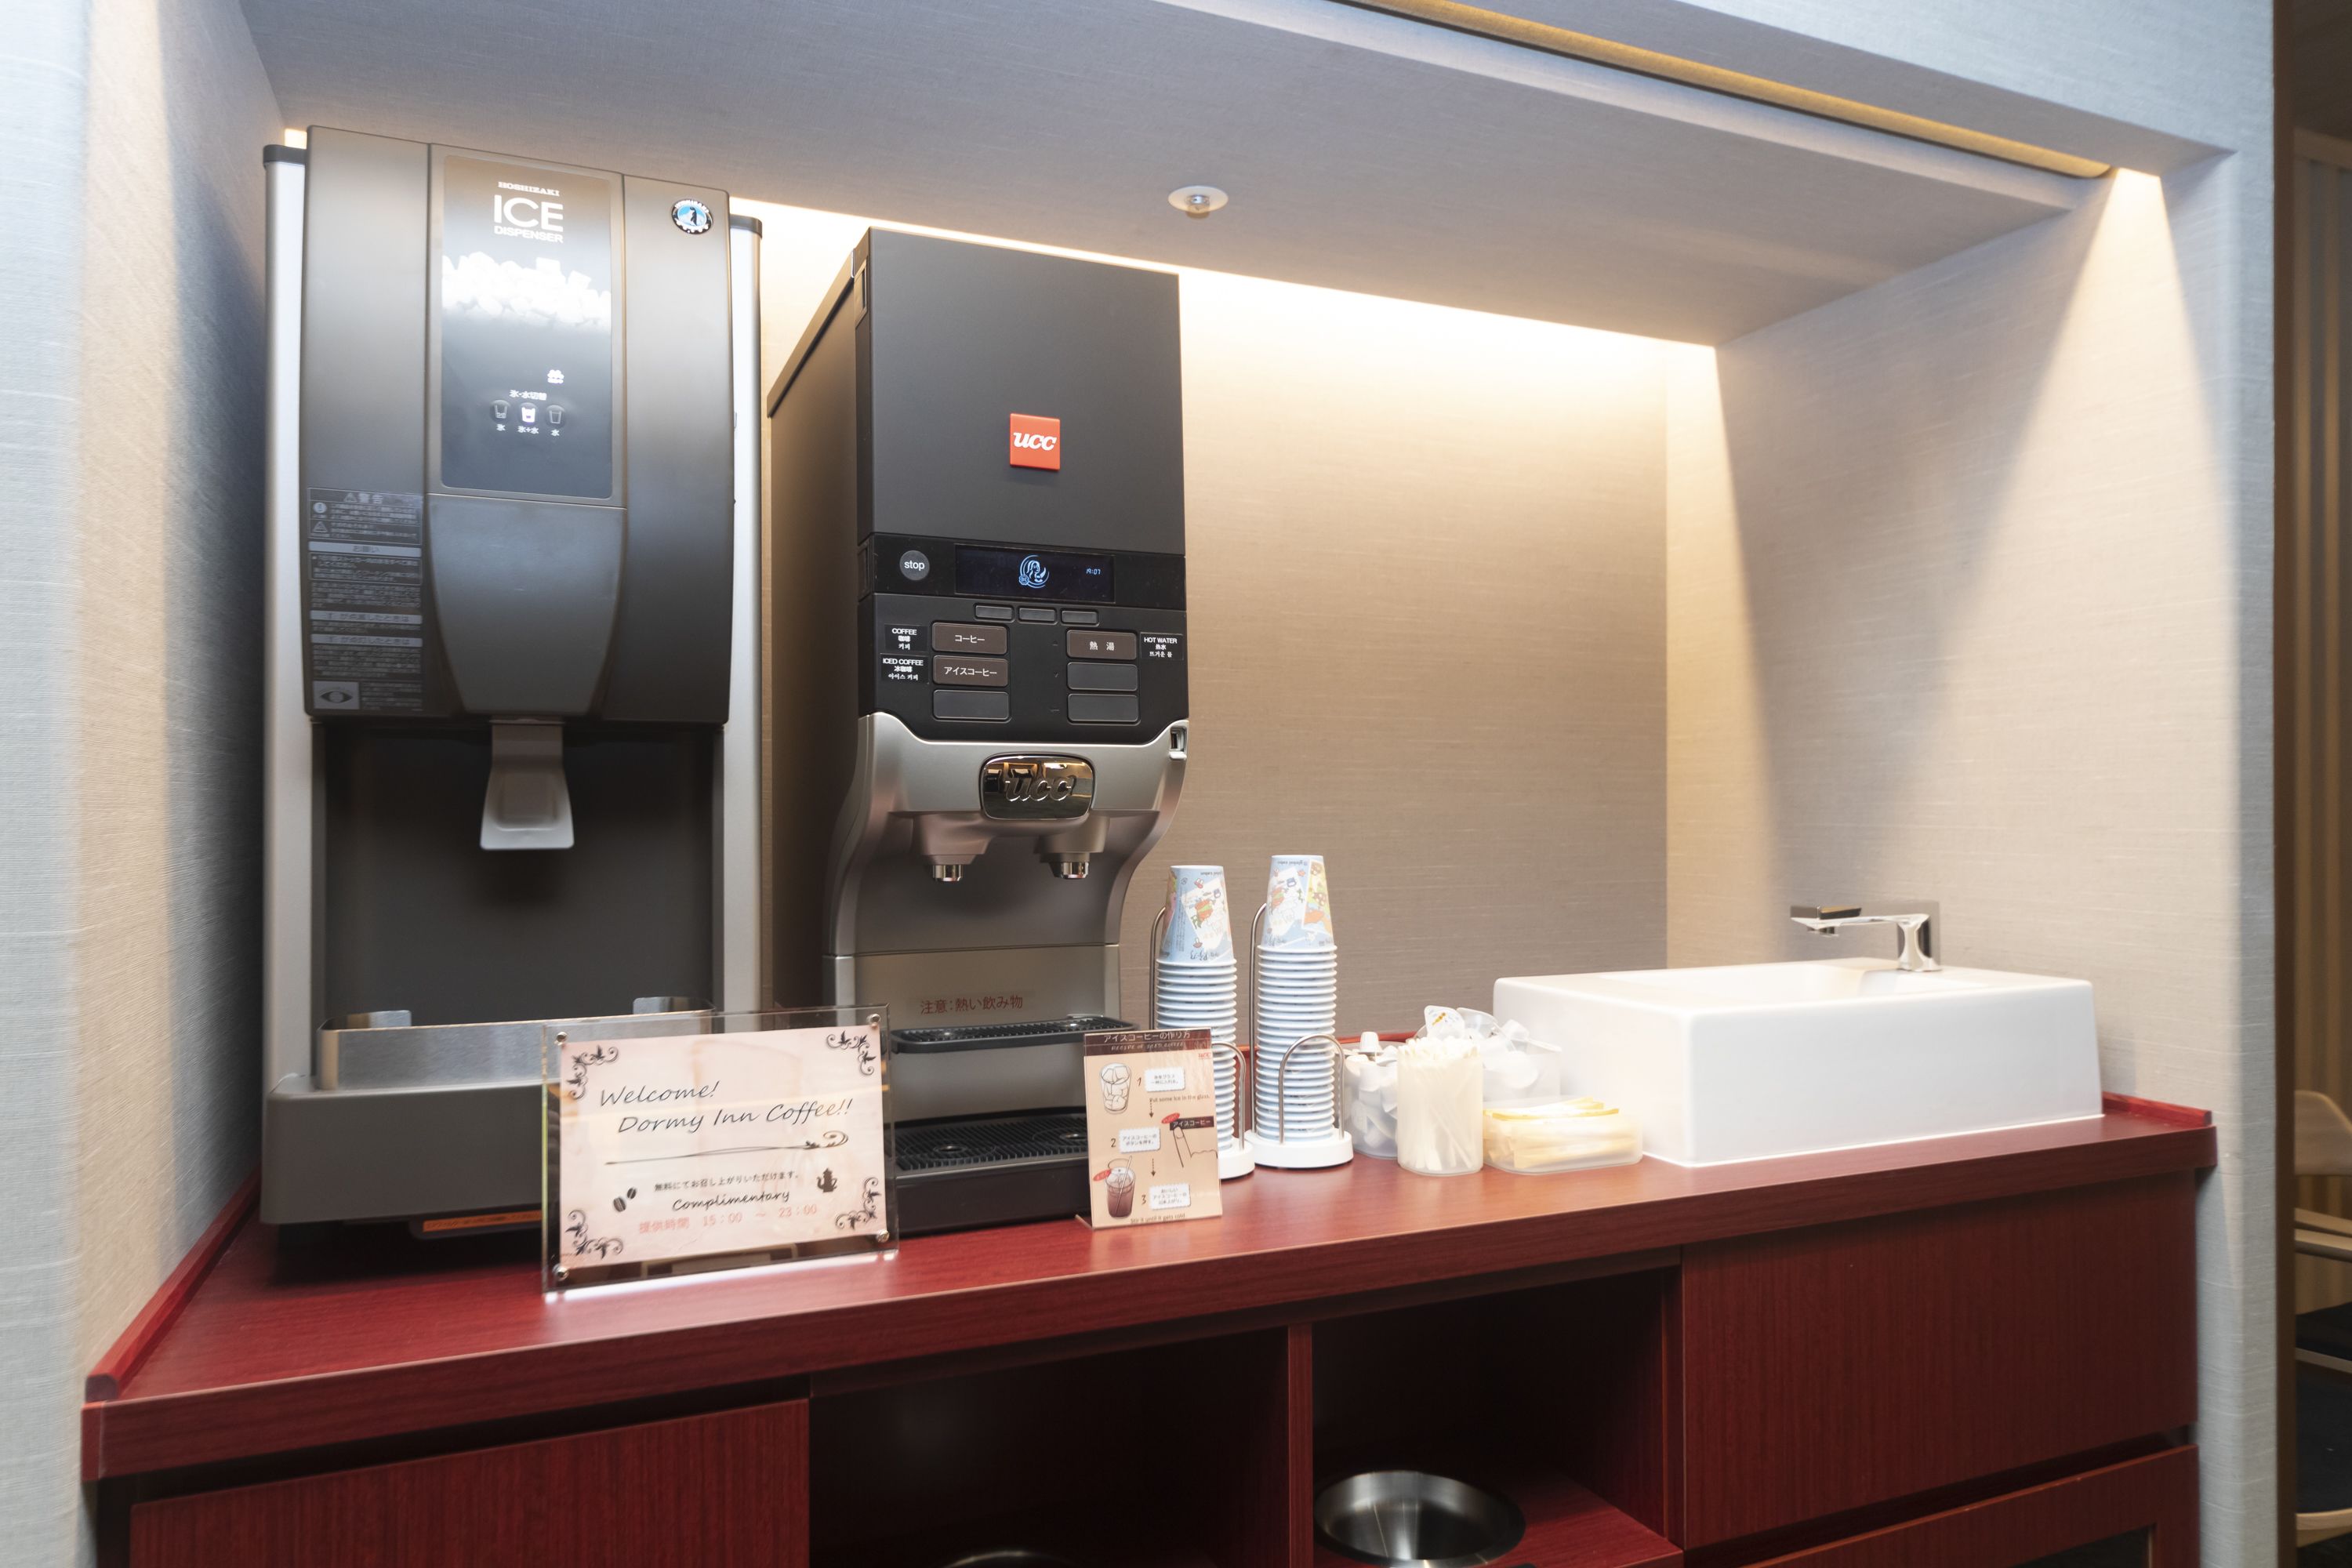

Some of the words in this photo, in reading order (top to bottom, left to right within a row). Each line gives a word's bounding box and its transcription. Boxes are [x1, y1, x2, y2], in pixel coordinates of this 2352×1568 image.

[494, 194, 564, 232] ICE
[494, 225, 564, 243] DISPENSER
[904, 560, 925, 571] stop
[955, 635, 985, 644] コーヒー
[944, 666, 997, 677] アイスコーヒー
[1104, 1031, 1191, 1043] アイスコーヒーの作り方
[601, 1080, 720, 1108] Welcome!
[618, 1115, 706, 1134] Dormy
[713, 1109, 759, 1126] Inn
[766, 1098, 854, 1126] Coffee!!
[1110, 1138, 1116, 1148] 2
[672, 1191, 790, 1211] Complimentary
[1142, 1194, 1147, 1205] 3
